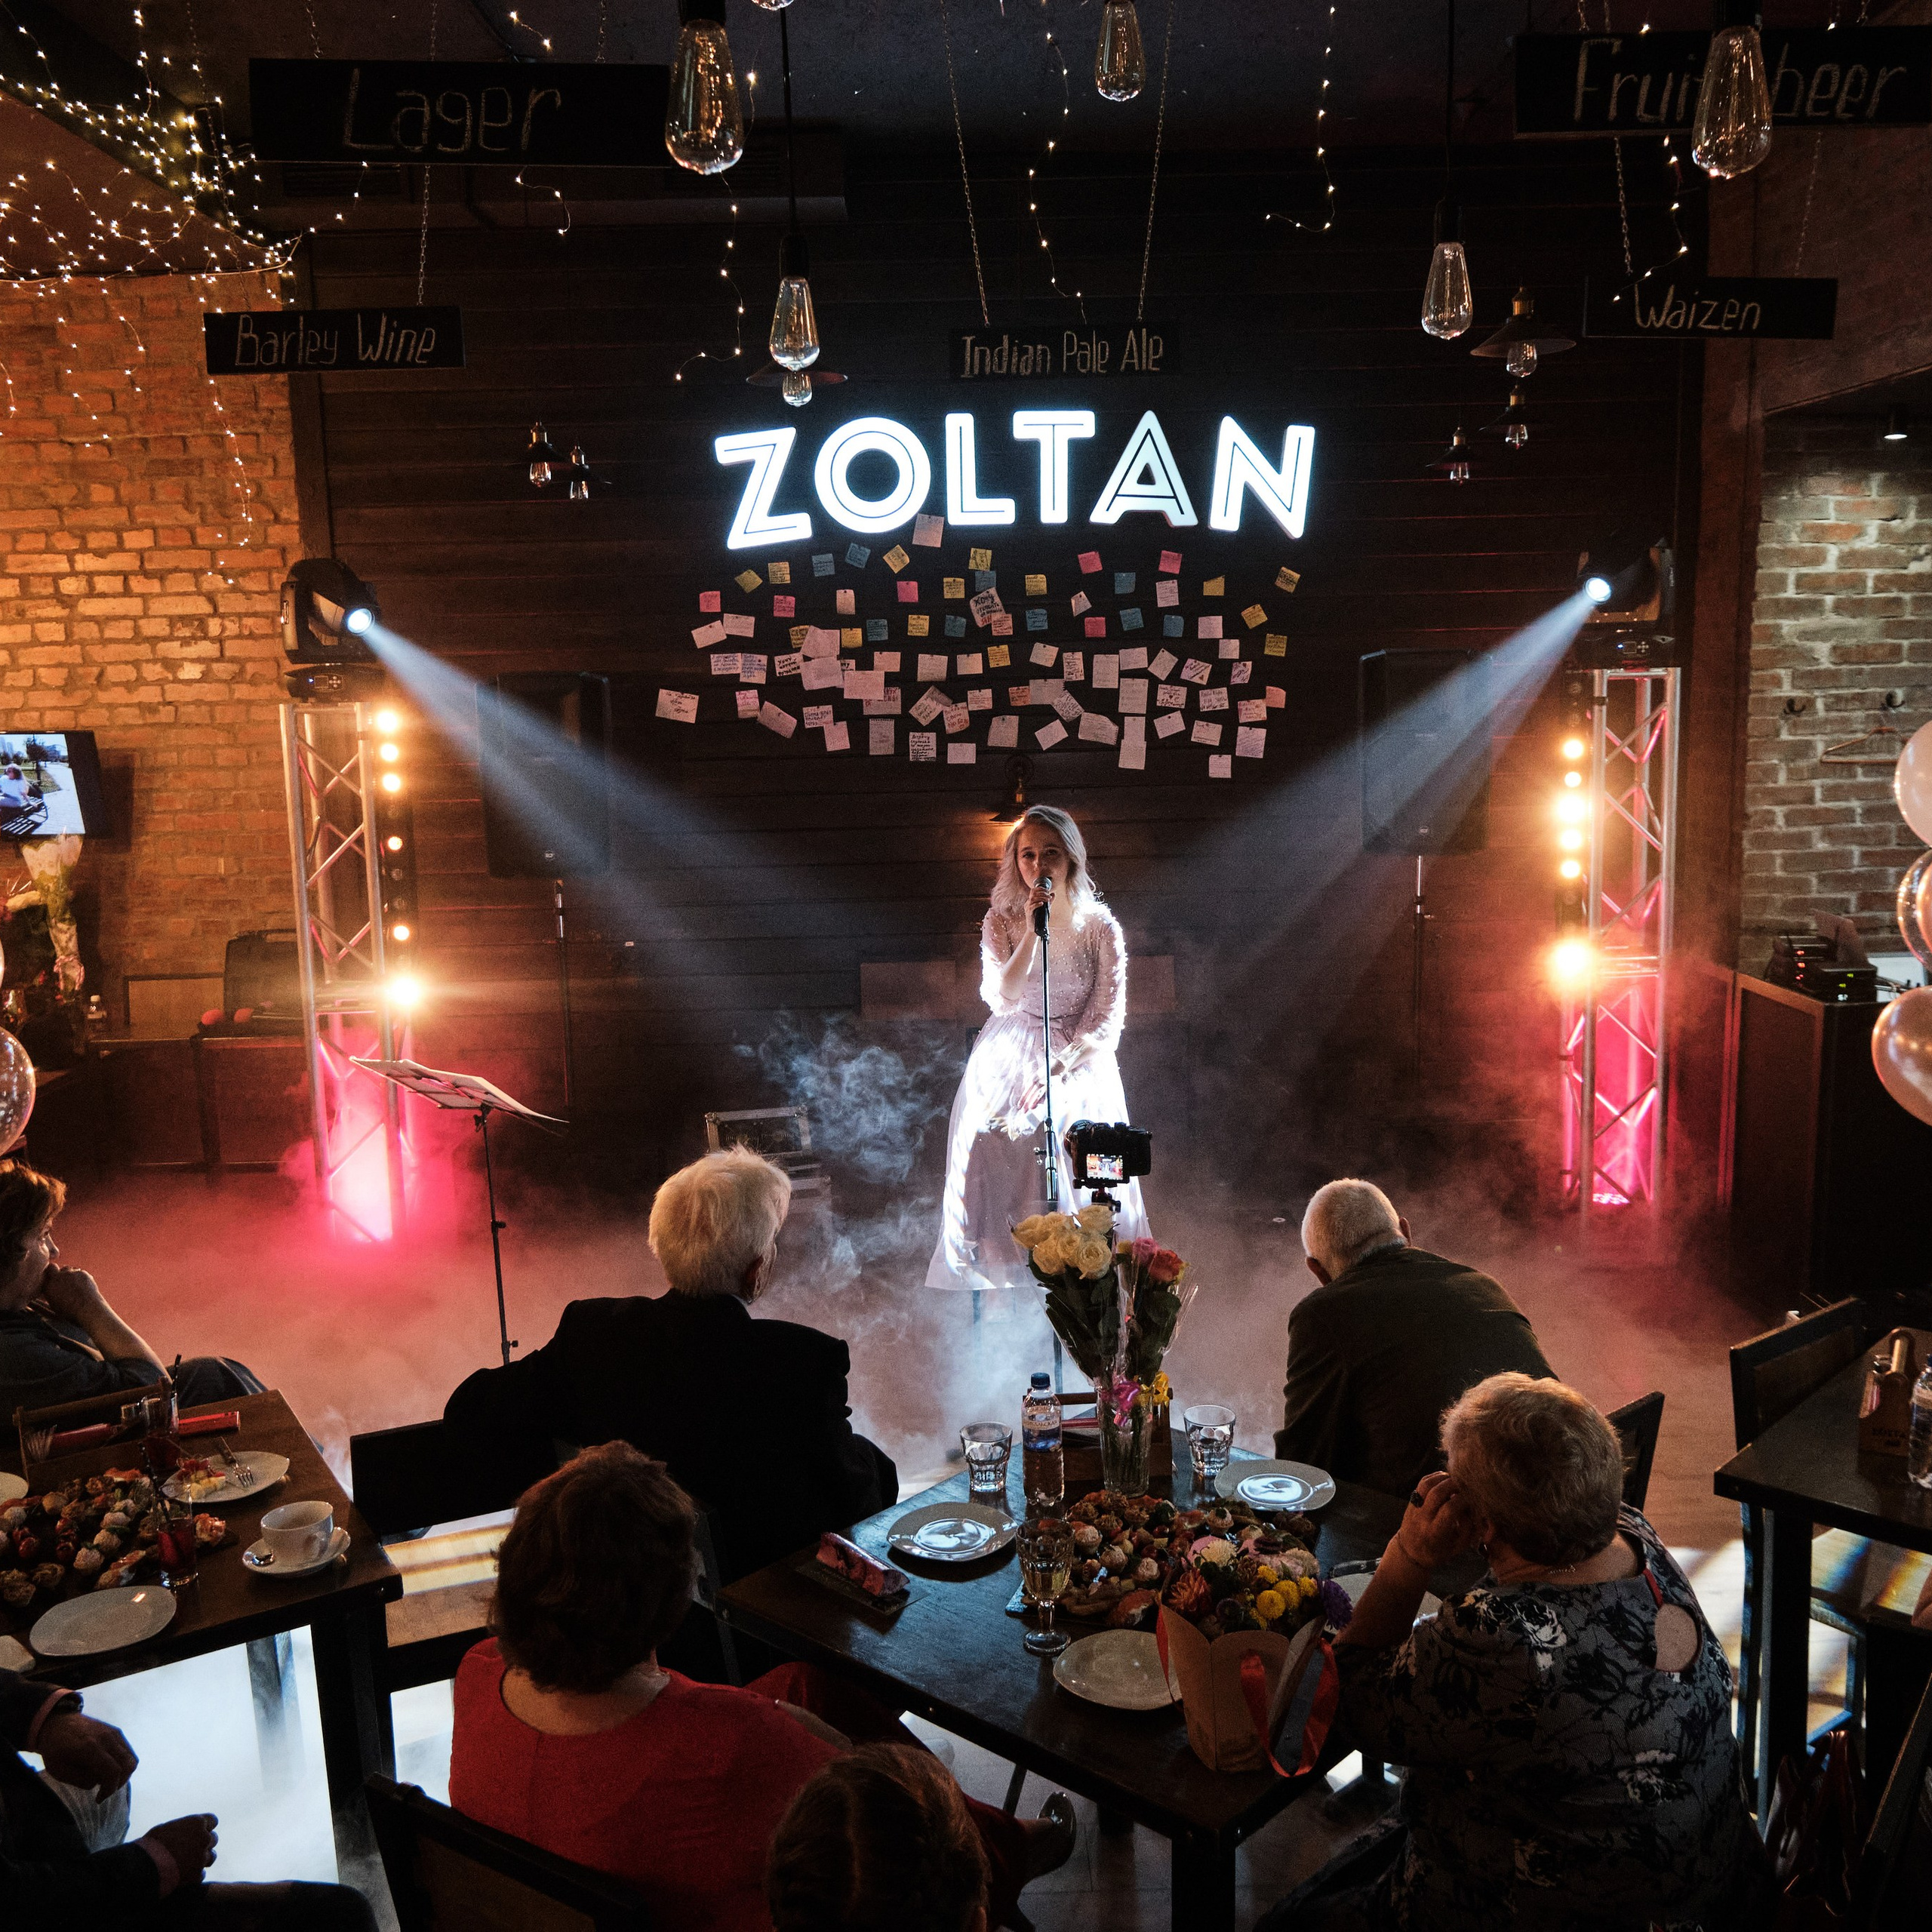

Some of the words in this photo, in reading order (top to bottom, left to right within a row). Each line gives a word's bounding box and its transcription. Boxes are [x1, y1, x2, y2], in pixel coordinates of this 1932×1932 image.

[343, 67, 561, 152] Lager
[1574, 38, 1704, 123] Frui
[1769, 42, 1908, 118] beer
[234, 313, 339, 367] Barley
[356, 312, 436, 364] Wine
[1634, 283, 1761, 331] Waizen
[960, 334, 1052, 377] Indian
[1062, 330, 1109, 374] Pale
[1119, 328, 1164, 372] Ale
[714, 409, 1316, 551] ZOLTAN
